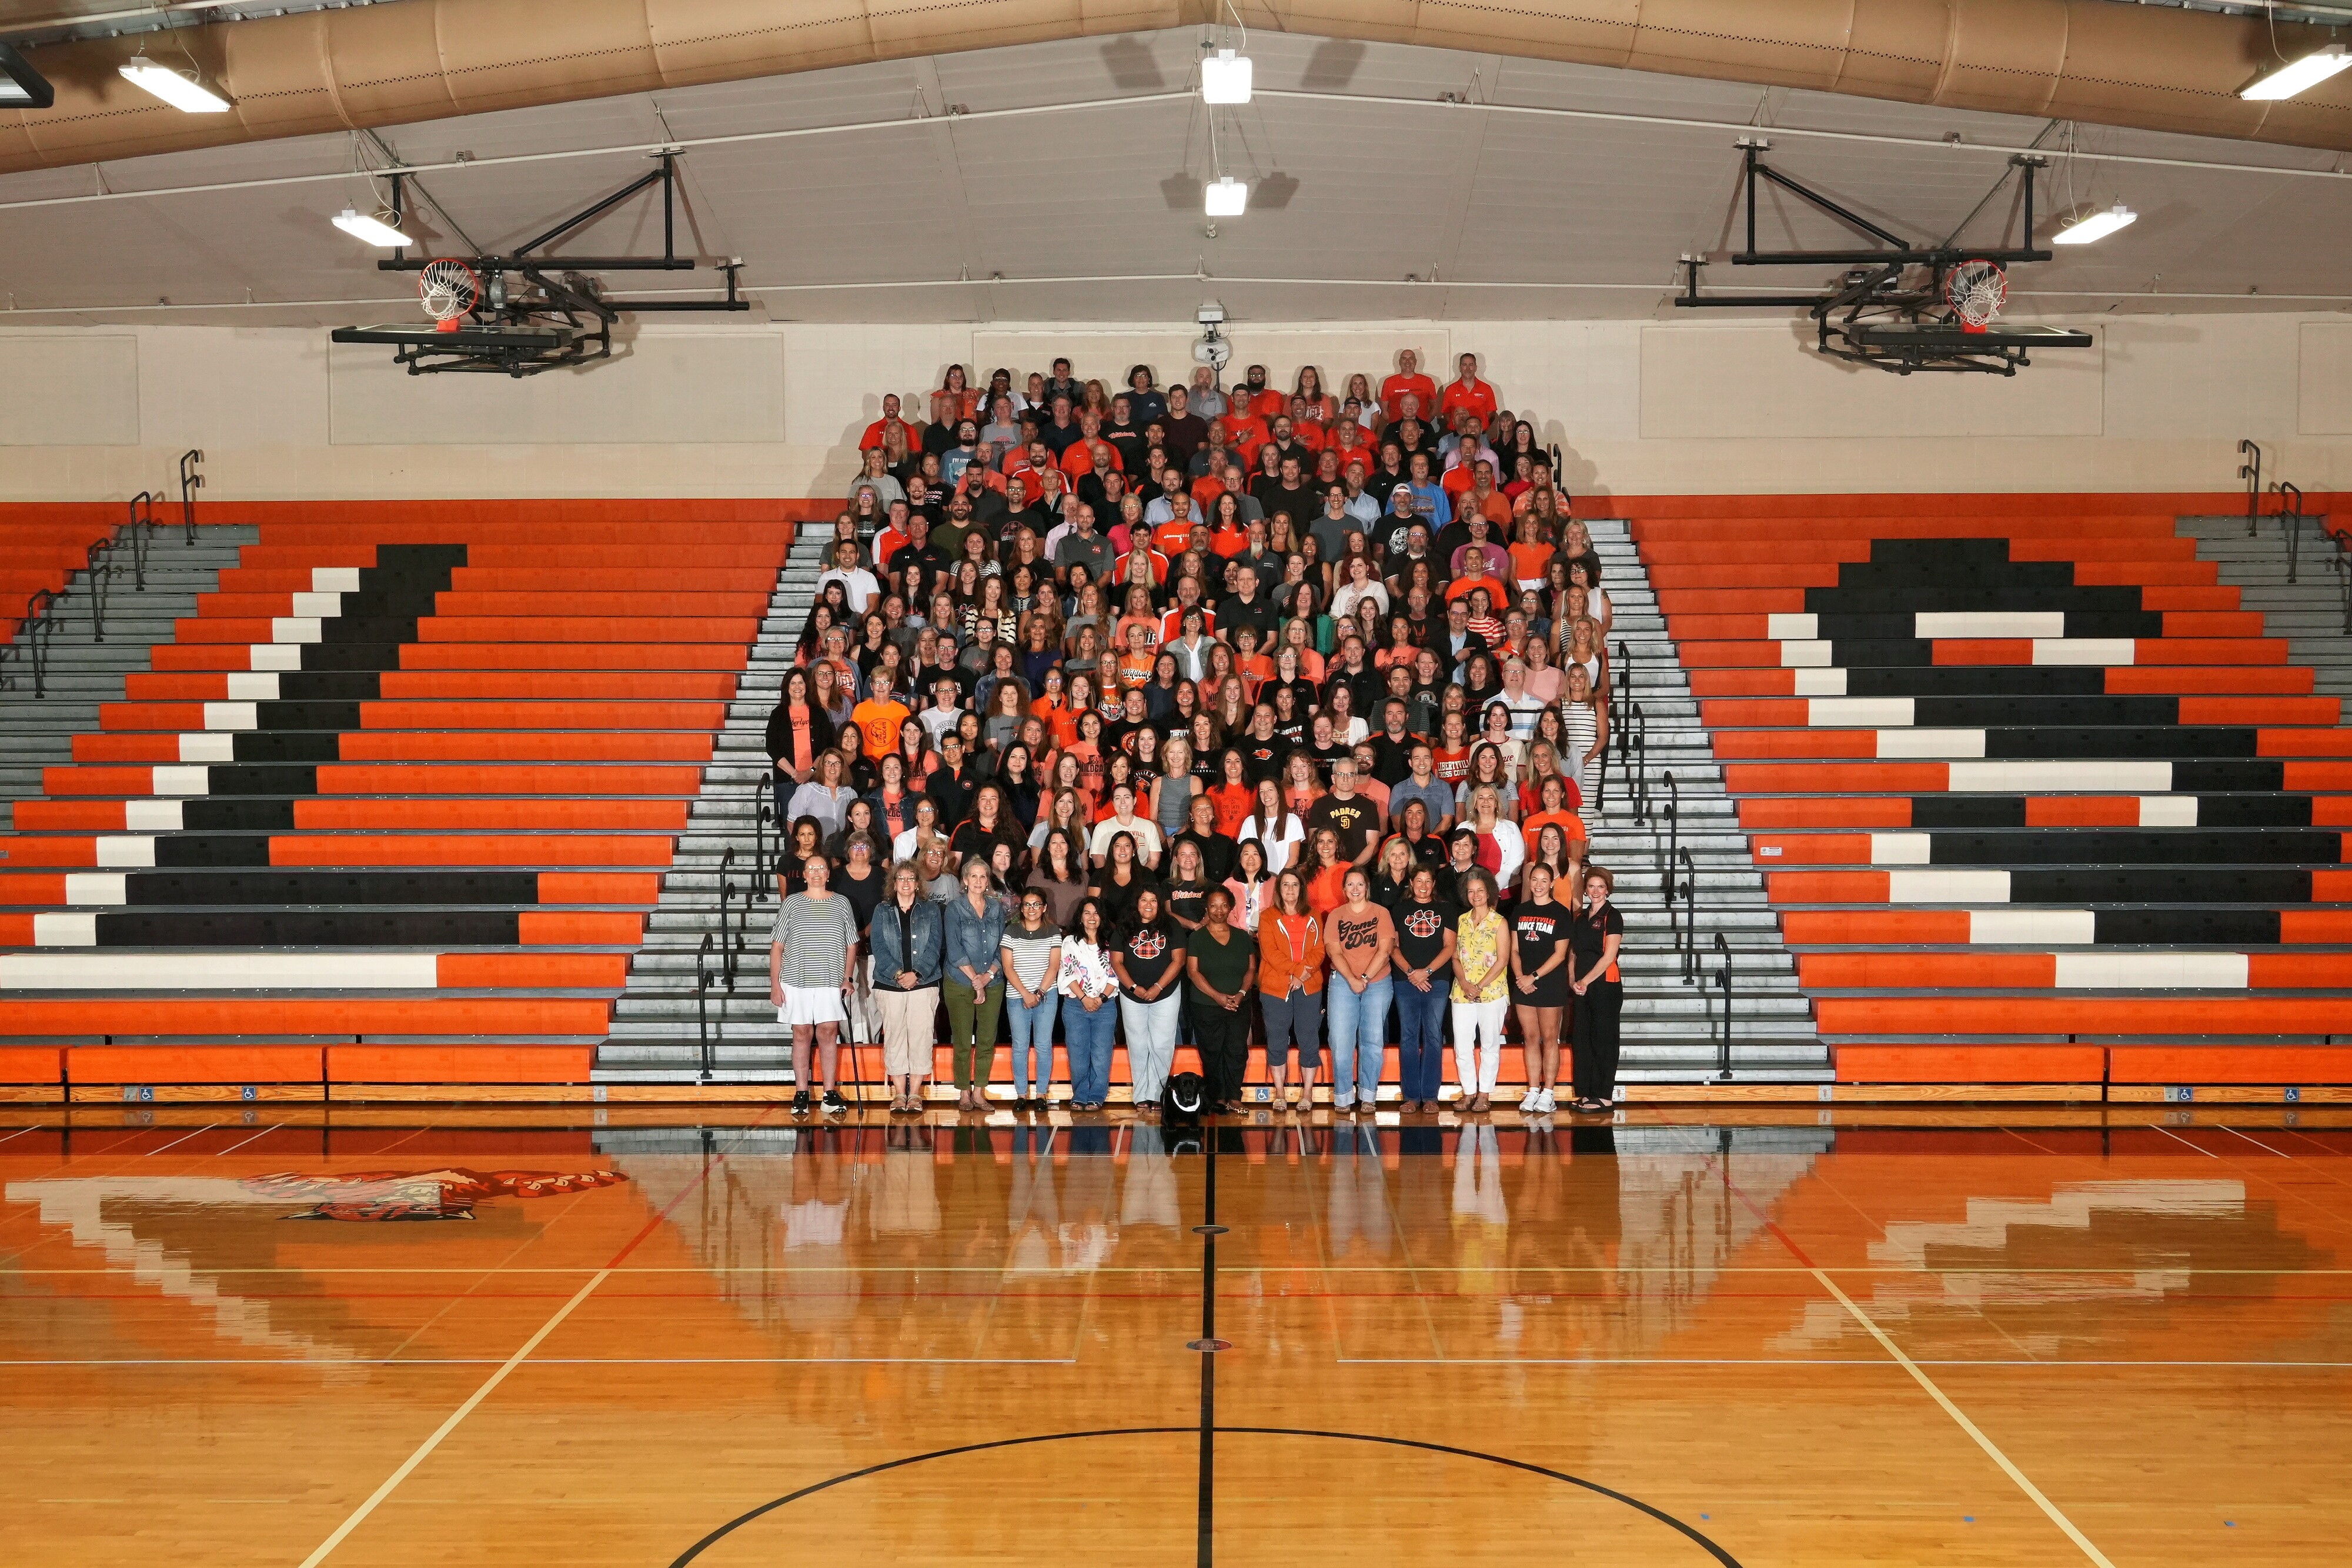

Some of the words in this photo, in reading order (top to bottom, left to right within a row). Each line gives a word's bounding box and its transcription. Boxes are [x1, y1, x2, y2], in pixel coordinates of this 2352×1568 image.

[1122, 668, 1152, 681] Wildcats
[1329, 807, 1361, 819] PADRES
[1341, 815, 1350, 828] SD
[1518, 921, 1535, 931] DANCE
[1535, 922, 1553, 934] TEAM
[1519, 916, 1556, 926] LIBERTYVILLE
[1338, 917, 1378, 941] Game
[1345, 931, 1377, 950] Day
